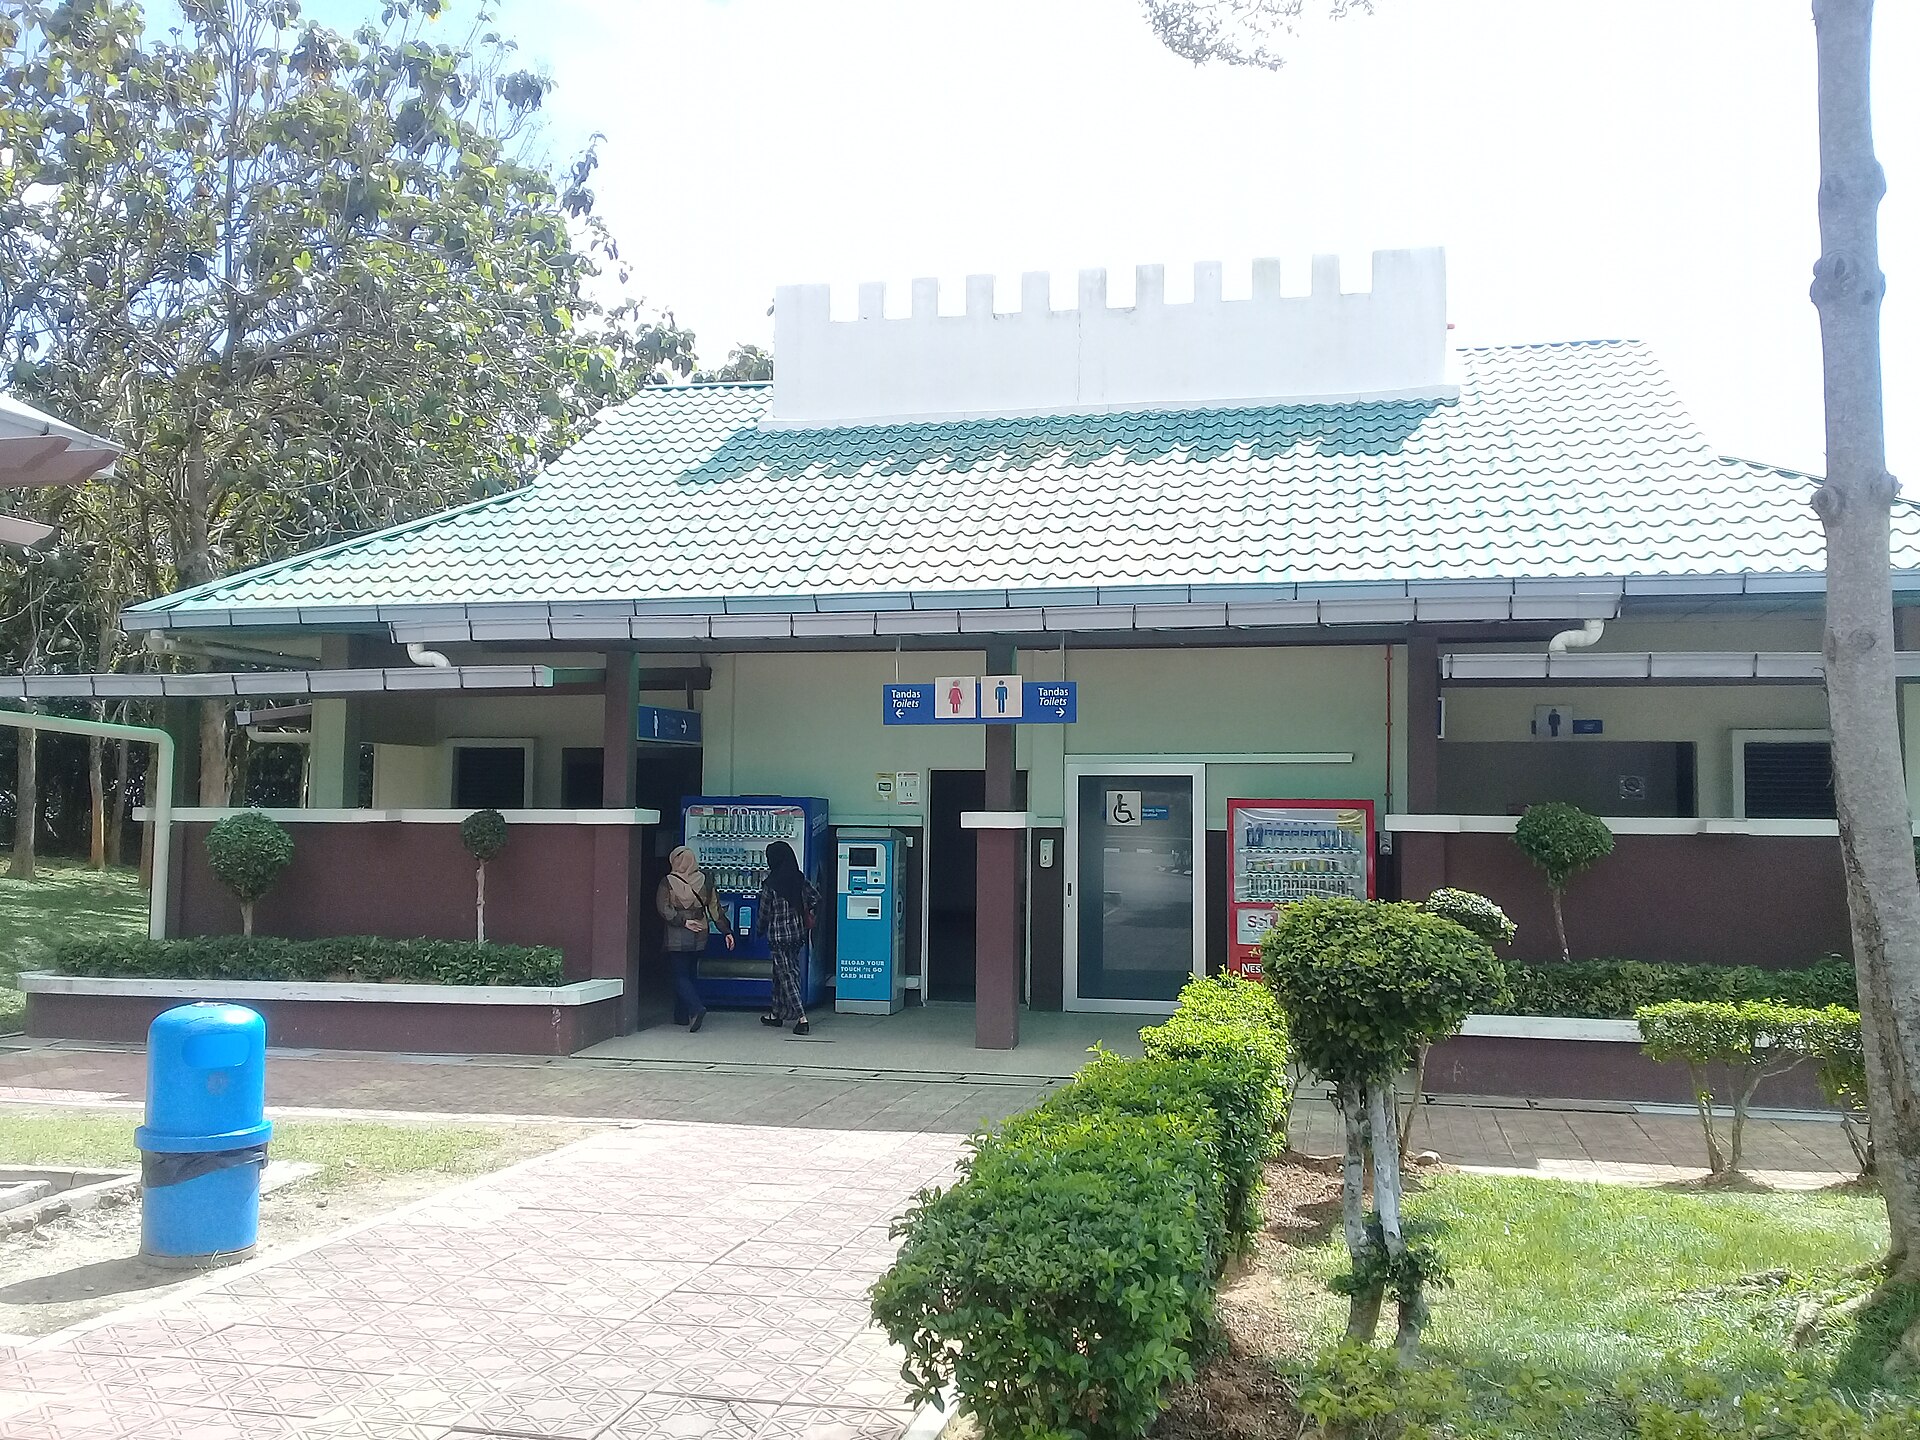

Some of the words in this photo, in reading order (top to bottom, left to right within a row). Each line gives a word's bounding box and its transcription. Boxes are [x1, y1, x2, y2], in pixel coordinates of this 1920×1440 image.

[891, 689, 921, 698] Tandas
[1037, 687, 1069, 697] Tandas
[892, 698, 920, 708] Toilets
[1038, 696, 1068, 706] Toilets
